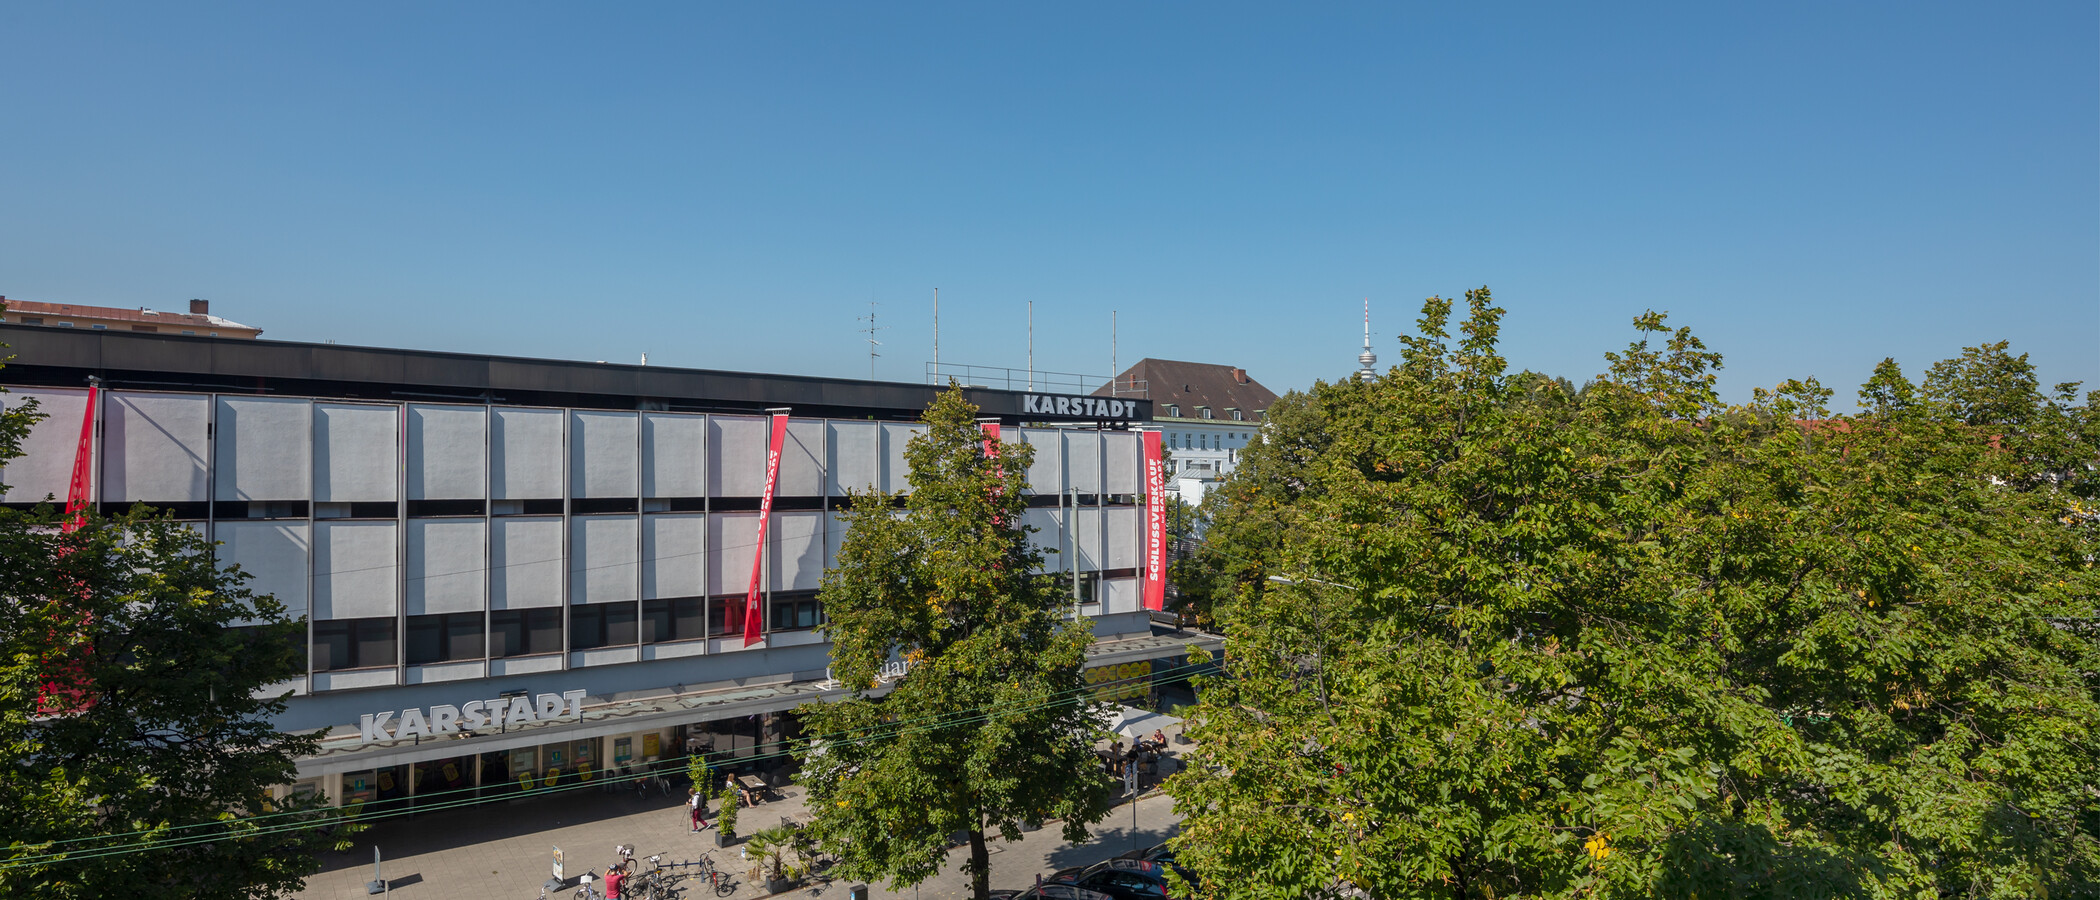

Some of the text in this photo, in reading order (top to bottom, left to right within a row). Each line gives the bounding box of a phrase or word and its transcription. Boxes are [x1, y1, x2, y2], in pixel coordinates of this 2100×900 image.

[1023, 394, 1136, 419] KARSTADT
[1149, 458, 1160, 581] SCHLUSSVERKAUF
[360, 688, 587, 744] KARSTADT
